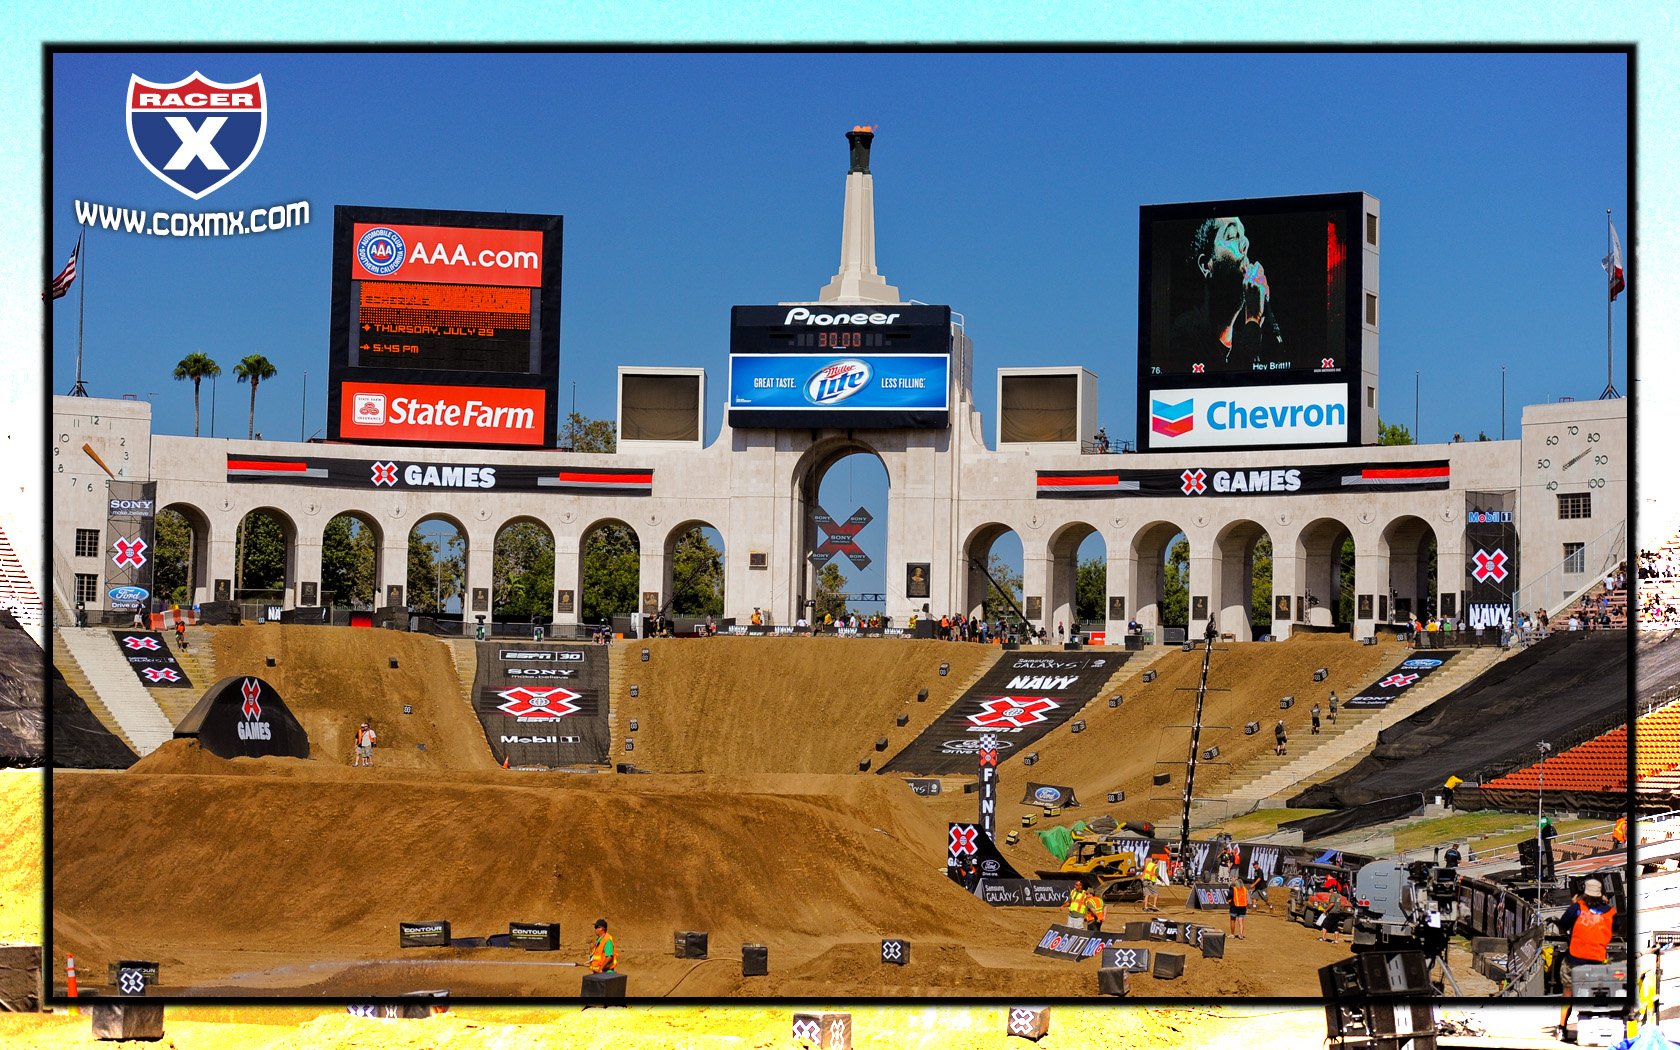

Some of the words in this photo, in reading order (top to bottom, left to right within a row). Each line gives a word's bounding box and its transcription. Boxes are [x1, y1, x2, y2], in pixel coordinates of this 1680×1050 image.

[390, 233, 403, 248] CLUB
[370, 243, 393, 257] AAA
[409, 242, 539, 270] AAA.com
[784, 307, 900, 326] Pioneer
[478, 328, 494, 337] 29
[373, 343, 400, 353] 5:45
[402, 345, 419, 353] PM
[823, 365, 856, 379] Miller
[1252, 363, 1268, 371] Hey
[754, 378, 774, 388] GREAT
[776, 378, 797, 388] TASTE.
[881, 378, 898, 388] LESS
[1206, 400, 1346, 431] Chevron
[1567, 425, 1579, 436] 70
[120, 438, 126, 447] 2
[1546, 435, 1560, 446] 60
[1587, 432, 1601, 443] 80
[53, 447, 60, 456] 9
[123, 451, 129, 461] 3
[1537, 458, 1551, 469] 50
[1594, 454, 1609, 466] 90
[57, 464, 64, 473] 8
[117, 467, 123, 476] 4
[404, 464, 497, 489] GAMES
[1213, 469, 1302, 493] GAMES
[71, 478, 77, 487] 7
[87, 483, 93, 492] 6
[1545, 480, 1559, 492] 40
[1587, 477, 1606, 489] 100
[110, 500, 153, 509] SONY
[1468, 511, 1500, 523] Mobil
[1469, 606, 1511, 627] NAVY
[505, 652, 552, 660] ESPN
[559, 652, 581, 660] 3D
[1005, 676, 1080, 690] NAVY
[237, 721, 272, 741] GAMES
[500, 735, 557, 744] Mobil
[948, 858, 978, 867] GAS
[985, 884, 1005, 892] Samsung
[1033, 885, 1054, 893] Samsung
[986, 893, 1012, 902] GALAXY
[1012, 890, 1020, 904] S
[1034, 893, 1061, 902] GALAXY
[1061, 890, 1069, 903] S
[1038, 929, 1079, 953] Mobil
